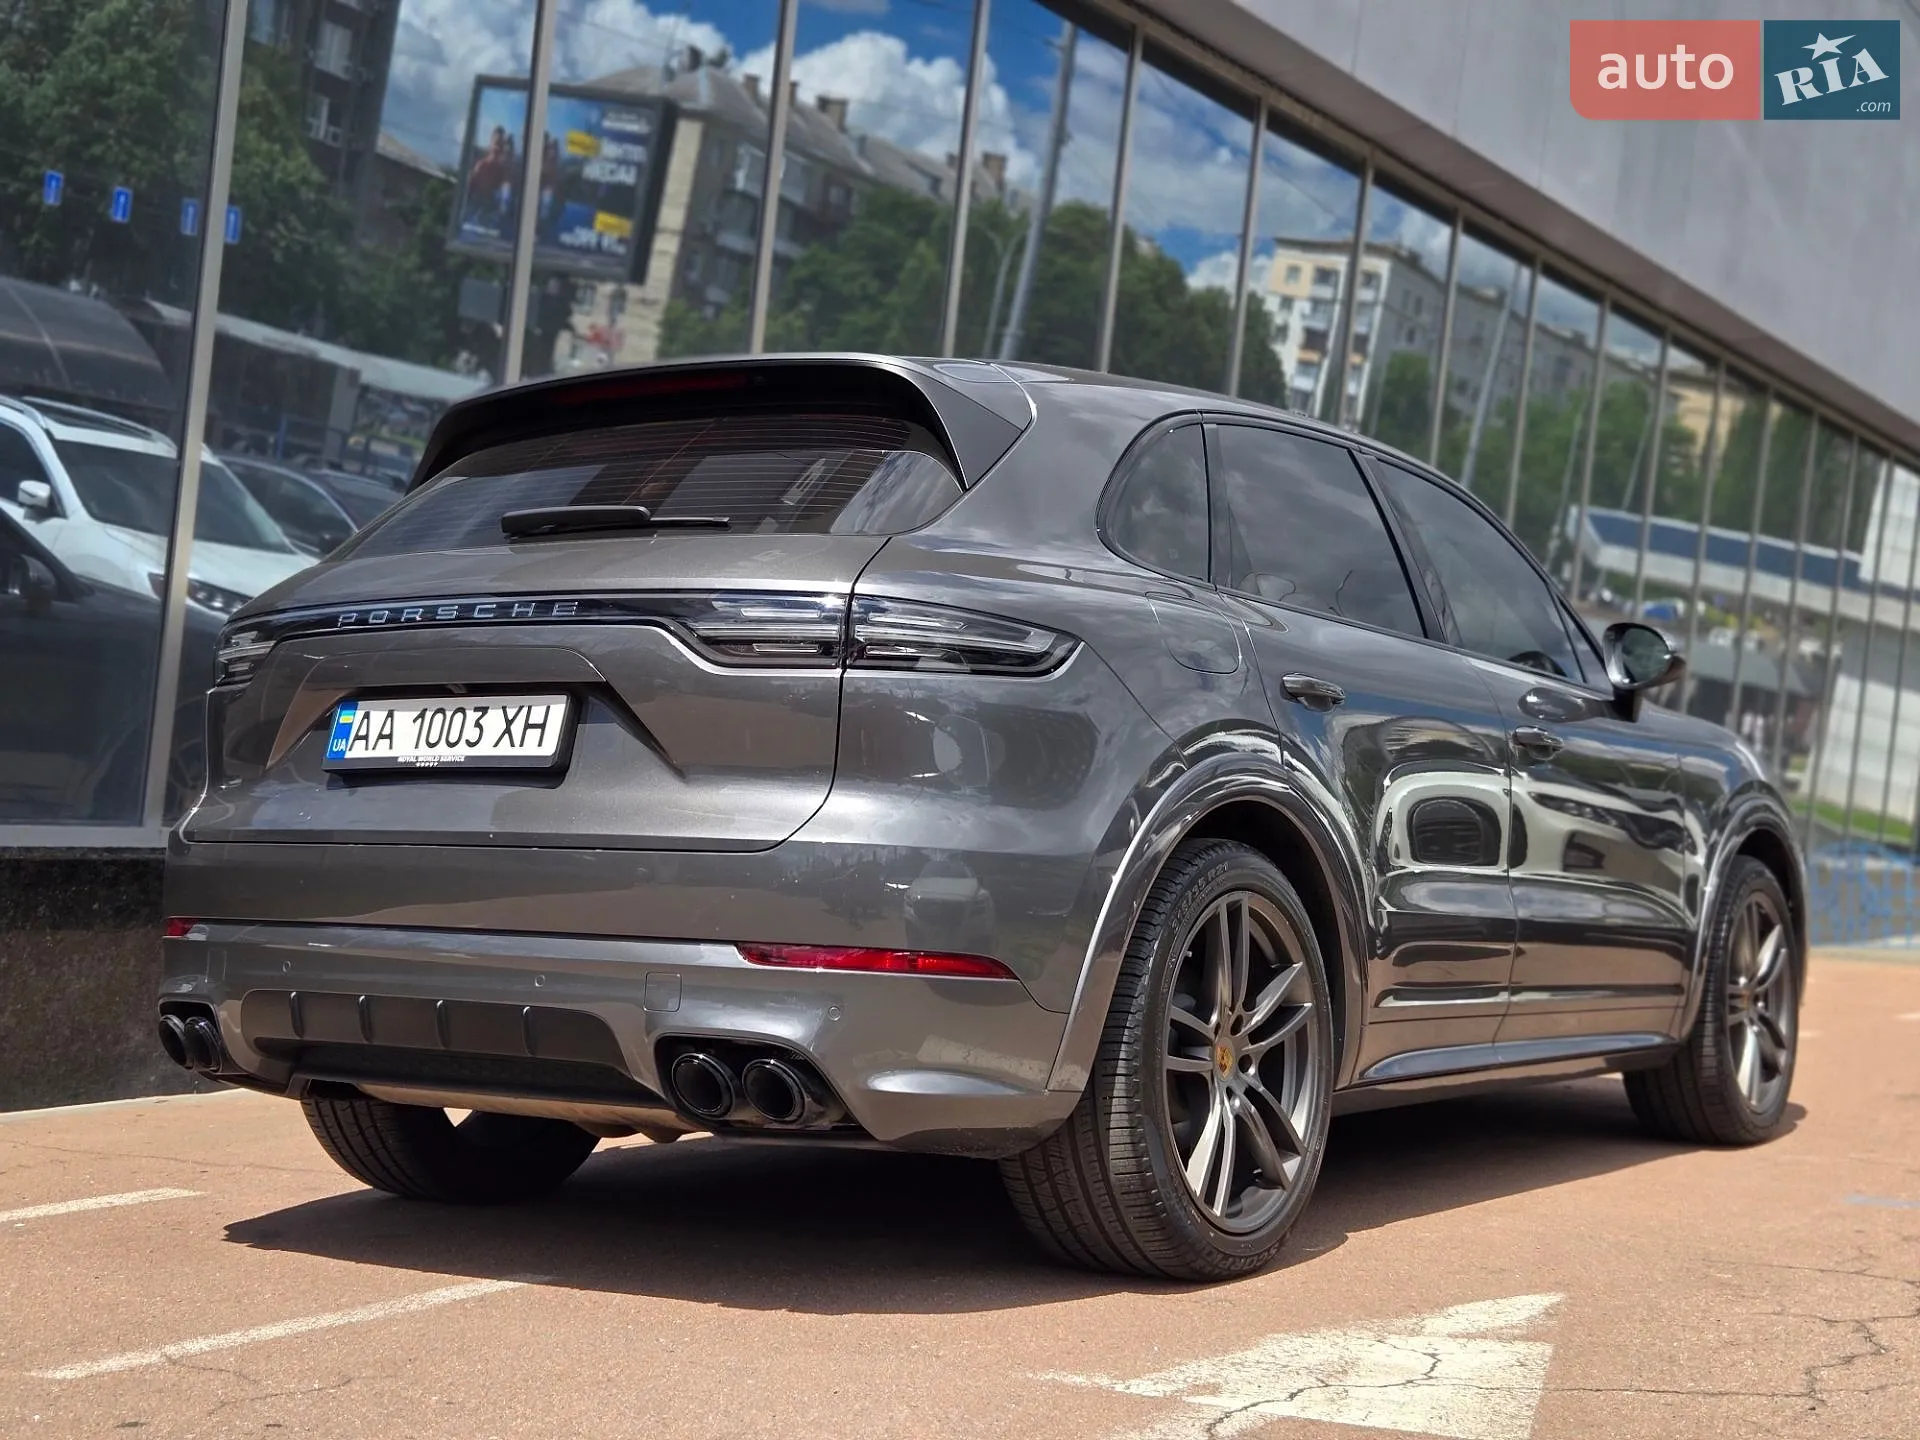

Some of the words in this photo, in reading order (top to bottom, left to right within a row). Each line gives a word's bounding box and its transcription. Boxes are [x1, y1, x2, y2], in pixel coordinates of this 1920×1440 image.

[337, 601, 579, 627] PORSCHE
[348, 709, 395, 752] AA
[413, 706, 489, 749] 1003
[493, 705, 551, 748] XH
[333, 738, 346, 752] UA
[440, 754, 466, 762] SERVICE
